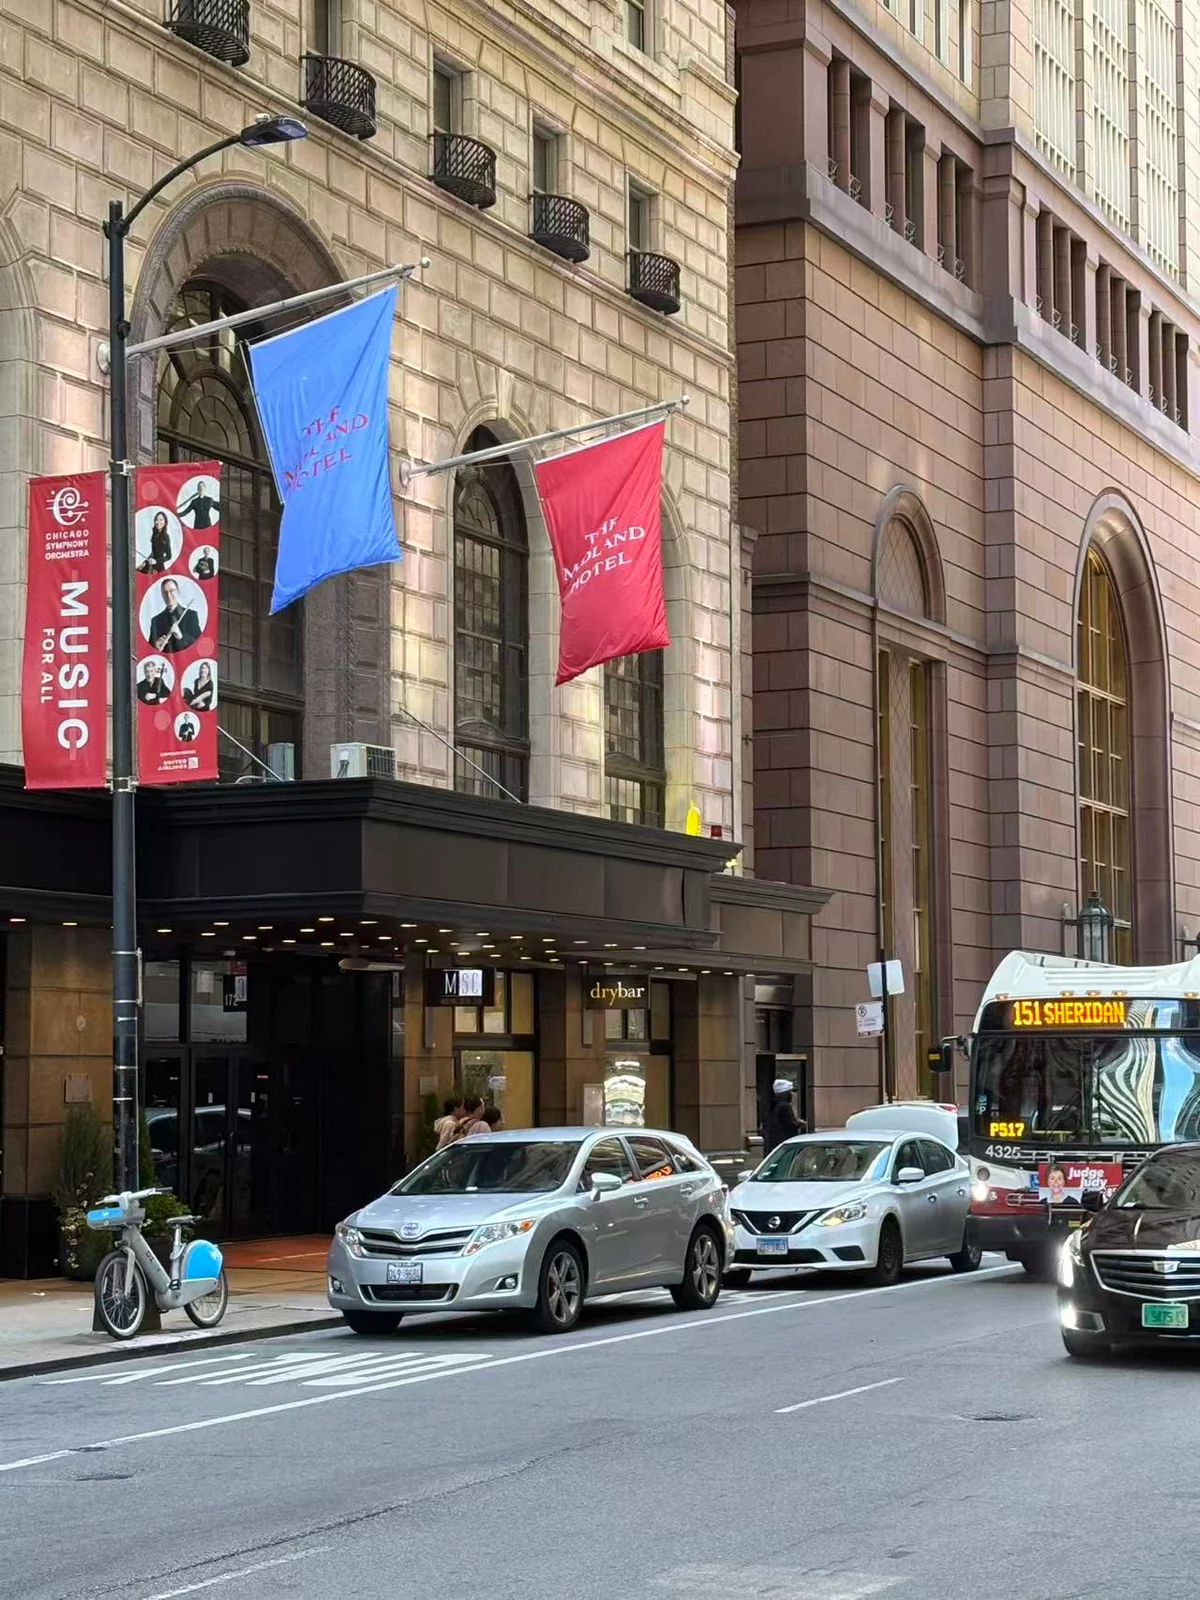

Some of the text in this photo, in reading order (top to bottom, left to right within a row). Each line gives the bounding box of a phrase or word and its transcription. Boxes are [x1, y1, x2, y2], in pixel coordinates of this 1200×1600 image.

[45, 529, 89, 540] CHICAGO
[45, 539, 89, 550] SYMPHONY
[45, 549, 89, 560] ORCHESTRA
[569, 551, 632, 595] HOTEL
[40, 627, 55, 704] FOR ALL
[58, 580, 89, 749] MUSIC
[445, 971, 479, 995] MSC
[590, 981, 645, 1006] drybar
[1013, 1001, 1125, 1025] 151 SHERIDAN
[989, 1122, 1025, 1137] P517
[1067, 1166, 1105, 1181] Judge
